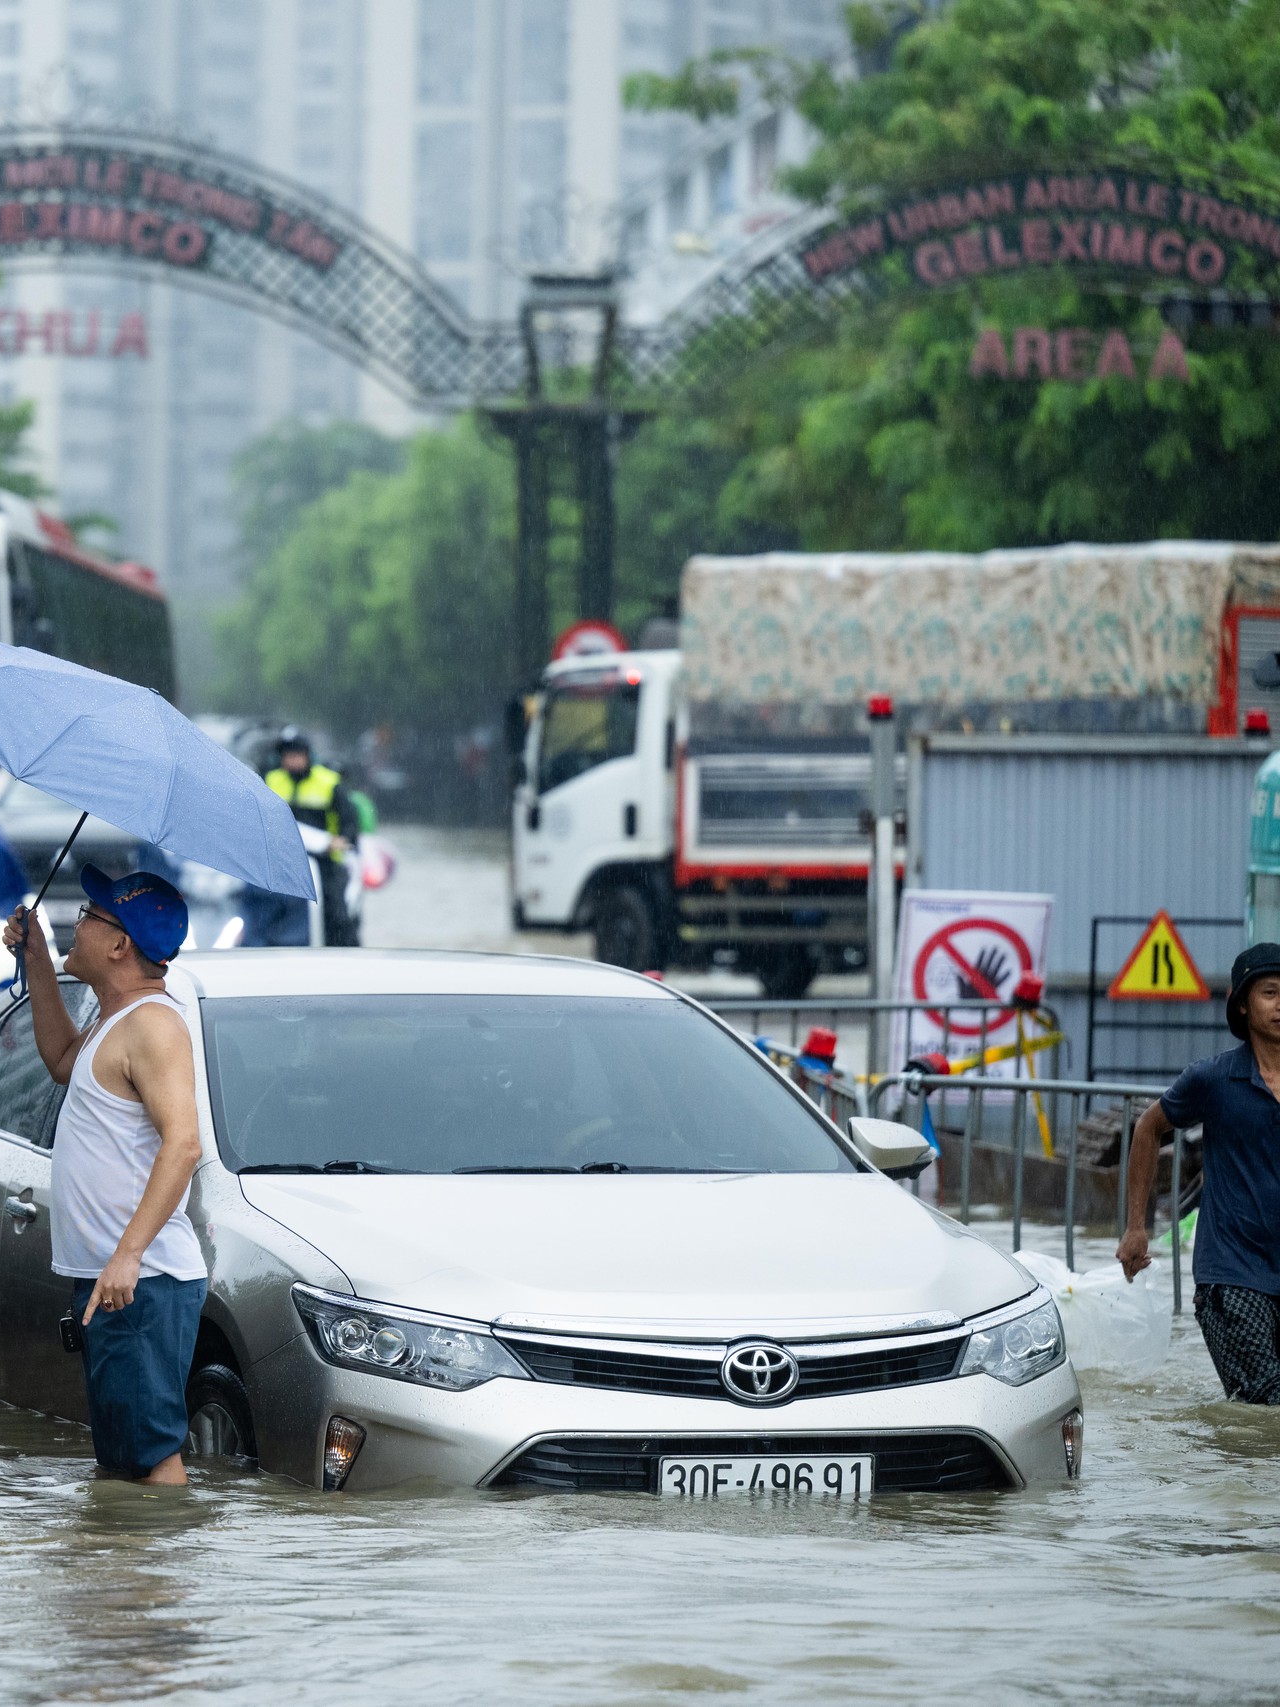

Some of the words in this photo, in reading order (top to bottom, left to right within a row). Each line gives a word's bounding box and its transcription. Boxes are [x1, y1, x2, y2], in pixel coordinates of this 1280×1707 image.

[804, 217, 884, 279] NEW
[887, 181, 1016, 242] URBAN
[1023, 176, 1120, 213] AREA
[915, 217, 1225, 285] GELEXIMCO
[110, 309, 150, 360] A
[971, 325, 1136, 380] AREA
[1149, 325, 1190, 381] A
